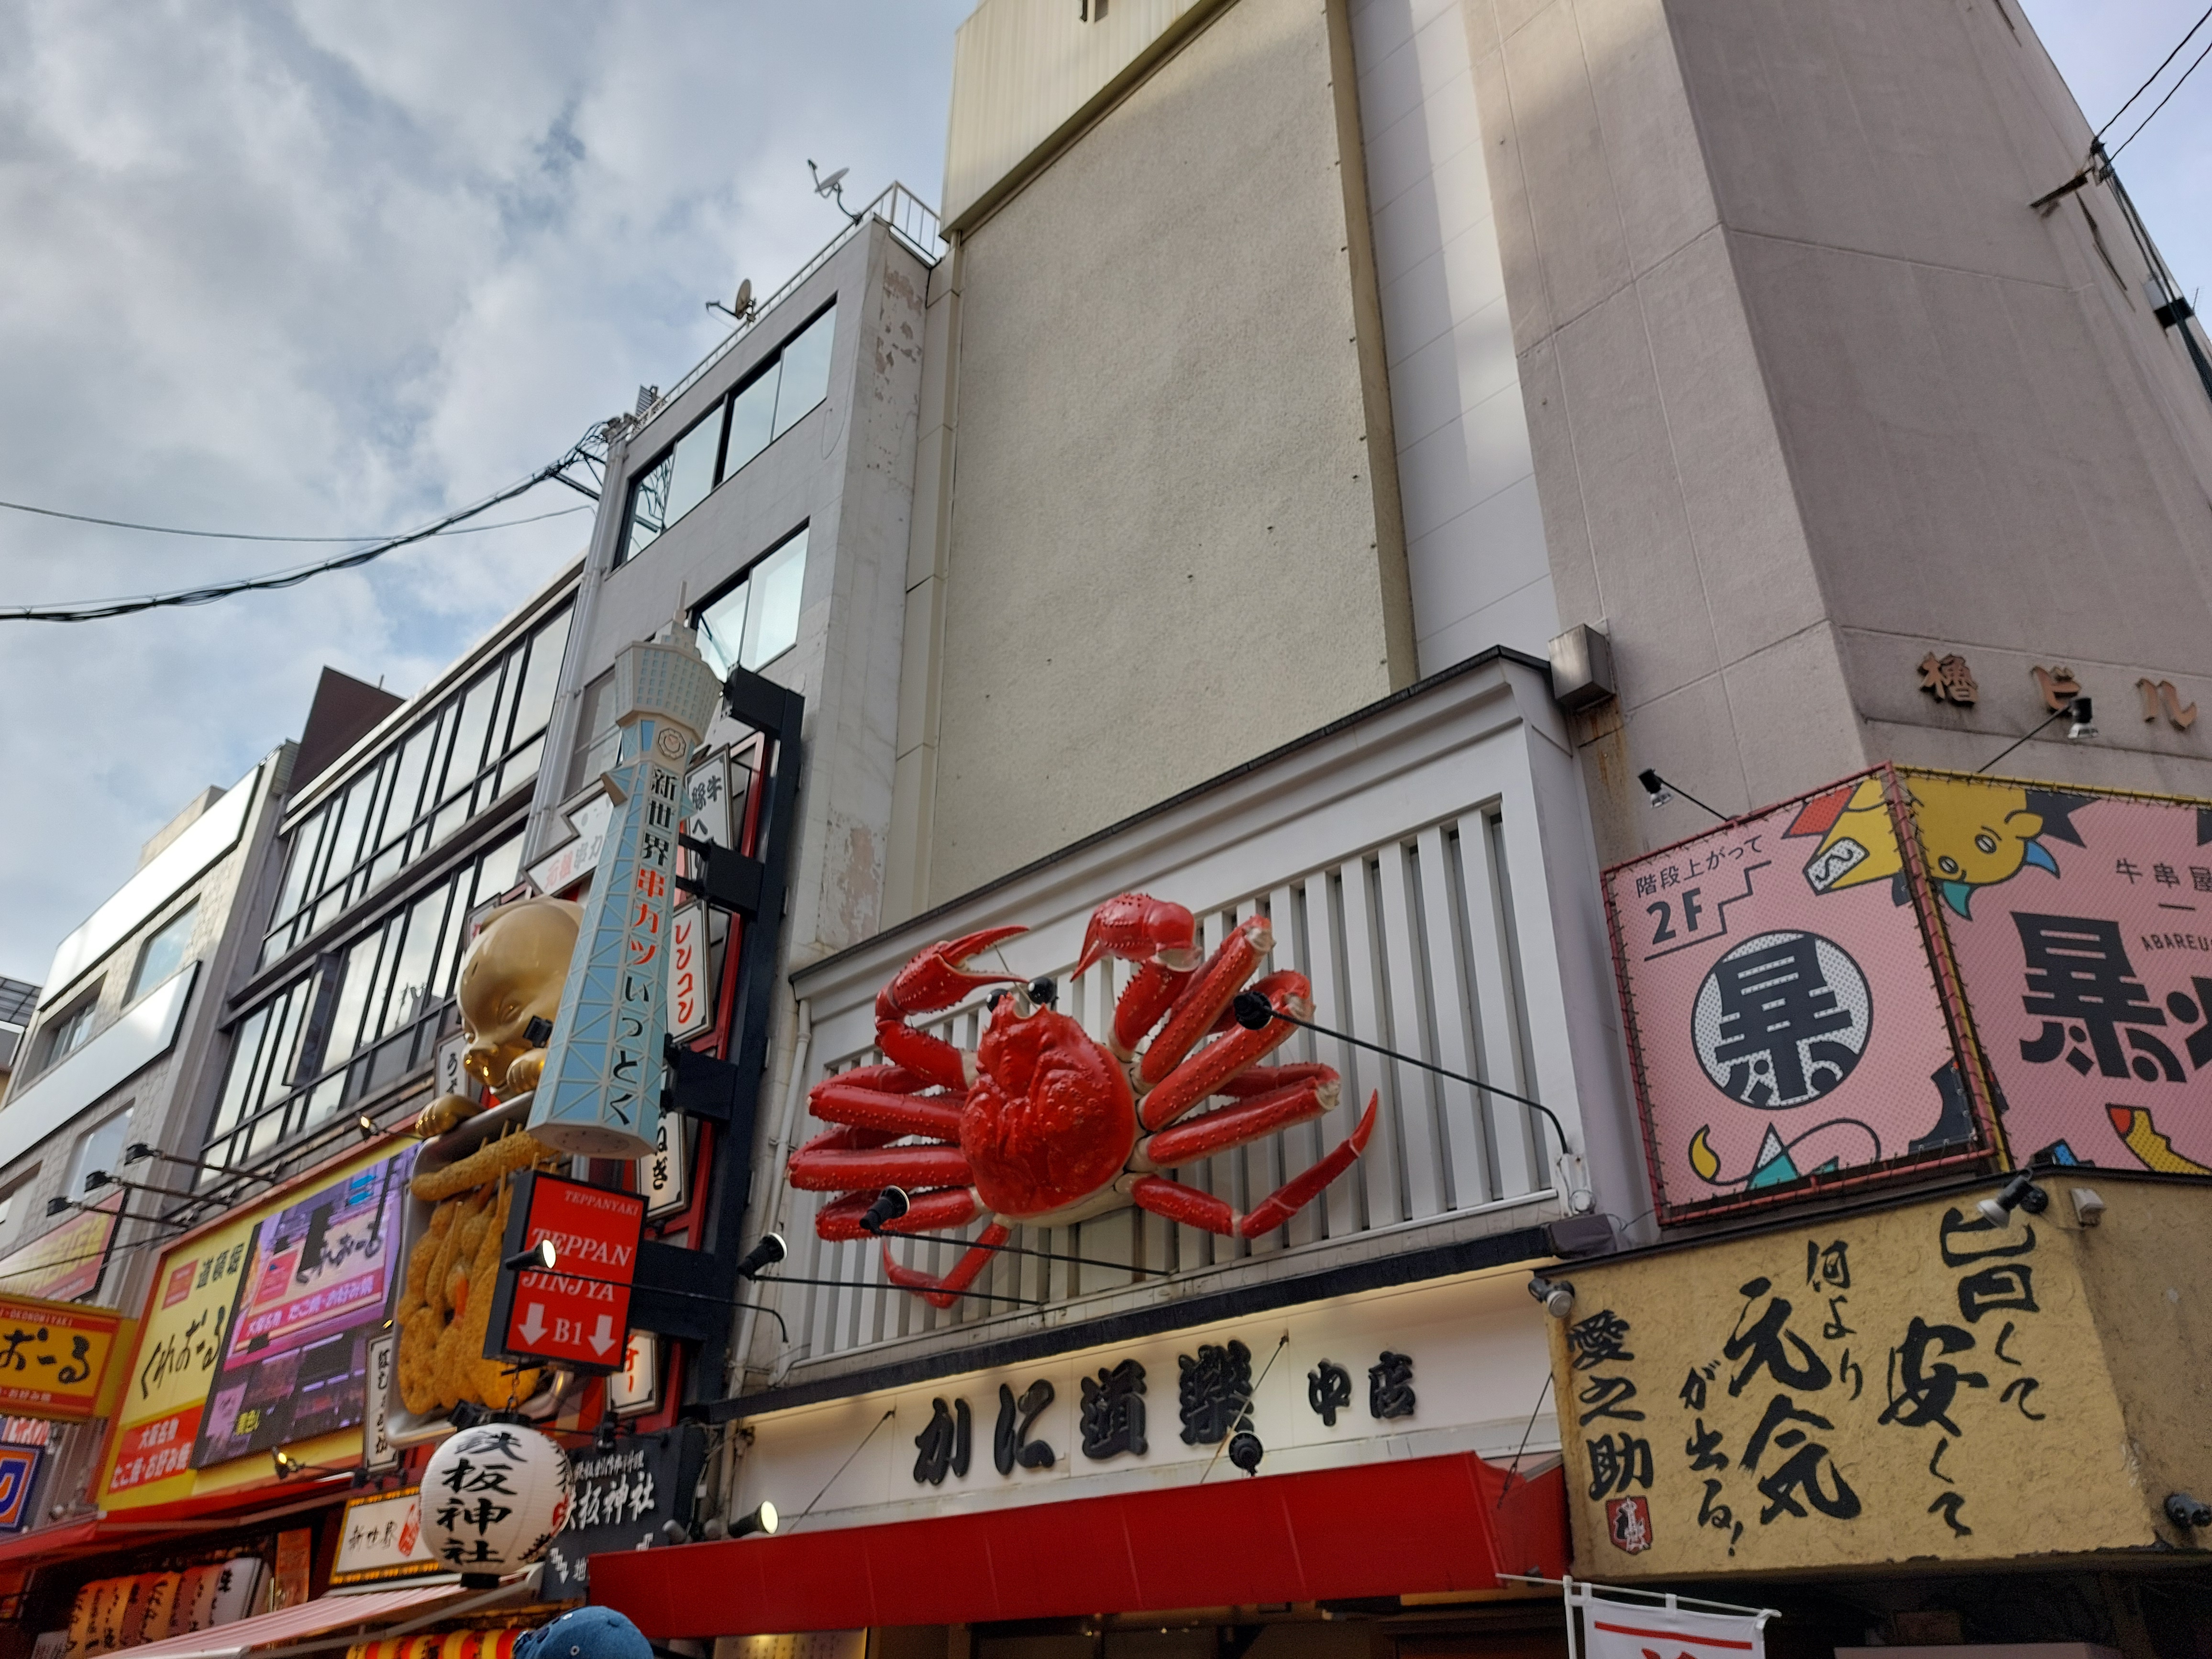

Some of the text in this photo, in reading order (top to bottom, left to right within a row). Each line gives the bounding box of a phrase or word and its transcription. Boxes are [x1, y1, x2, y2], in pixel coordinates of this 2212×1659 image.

[1636, 834, 1764, 898] 階段上がって
[1646, 887, 1703, 945] 2F
[2141, 933, 2212, 952] ABAREU
[675, 920, 694, 1024] レンコン
[565, 1190, 639, 1217] TEPPANYAKI
[531, 1228, 632, 1267] TEPPAN
[522, 1268, 615, 1302] JINJYA
[553, 1317, 582, 1346] B1
[1807, 1240, 1863, 1401] 何より
[1307, 1350, 1416, 1427] 中店
[1566, 1309, 1654, 1501] 愛之助
[1723, 1276, 1862, 1525] 元気
[1878, 1316, 1989, 1537] 安くて
[436, 1431, 528, 1565] 鉄板神社
[570, 1471, 655, 1531] 板神社
